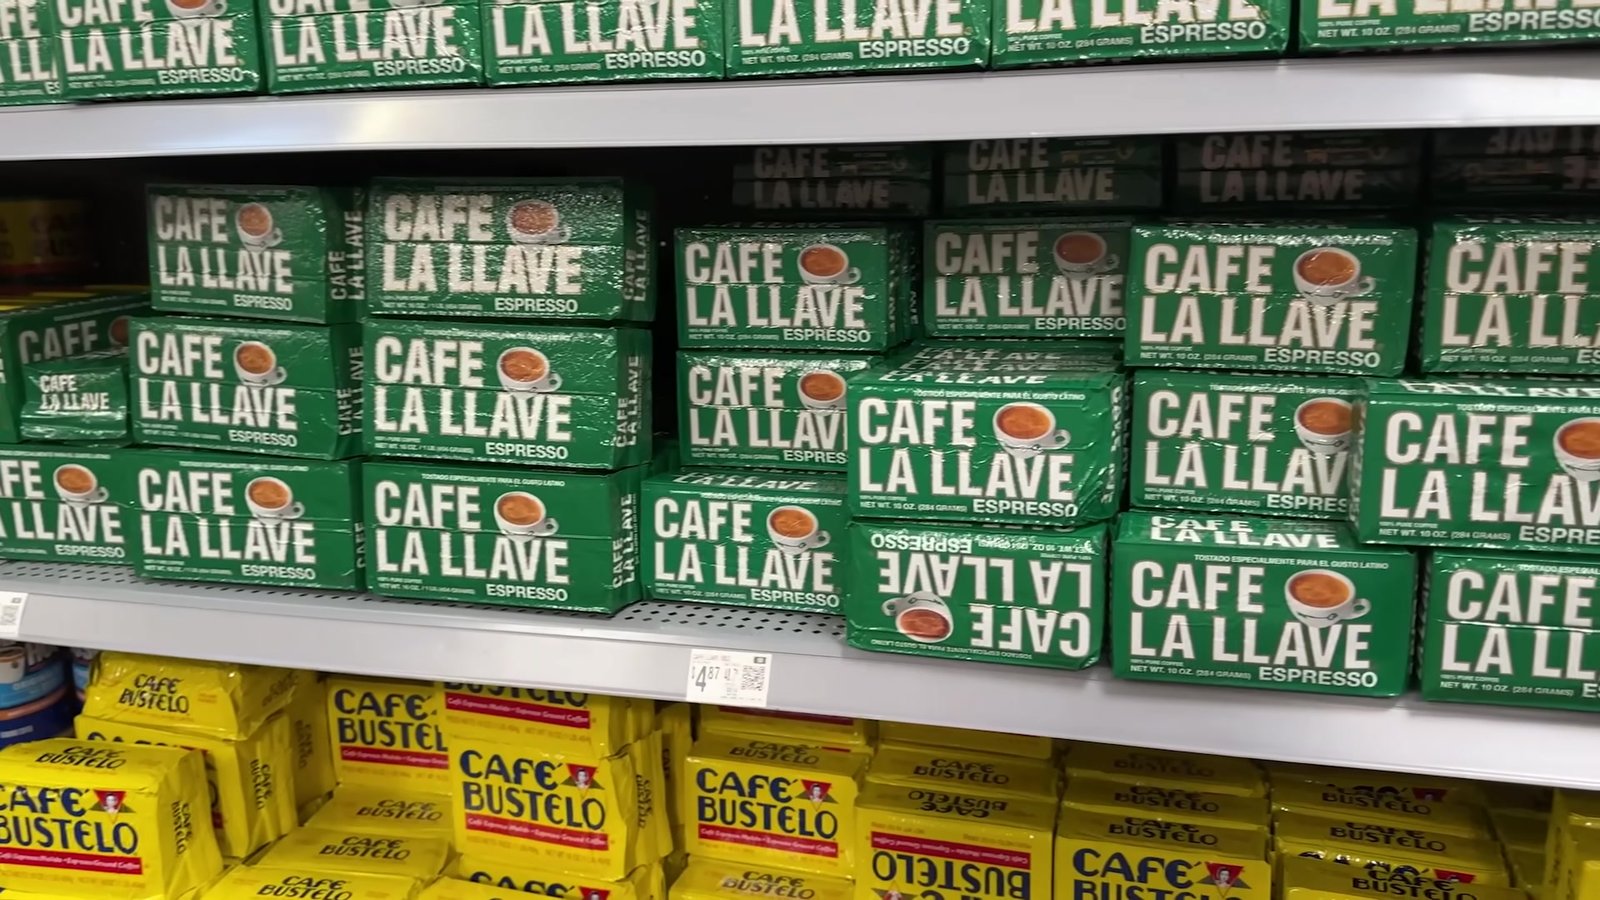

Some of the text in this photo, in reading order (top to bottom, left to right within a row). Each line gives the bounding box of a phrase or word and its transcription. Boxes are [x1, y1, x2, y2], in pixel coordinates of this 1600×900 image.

[272, 8, 458, 66] LA LLAVE
[495, 0, 699, 57] LA LLAVE
[740, 0, 802, 46] LA
[1141, 23, 1267, 44] ESPRESSO
[1318, 29, 1336, 38] NET
[1339, 29, 1358, 37] WT.
[1362, 27, 1372, 36] 10
[1375, 27, 1391, 36] OZ.
[1419, 24, 1460, 35] GRAMS)
[63, 20, 235, 73] LA LLAVE
[605, 51, 705, 70] ESPRESSO
[859, 38, 970, 59] ESPRESSO
[158, 67, 243, 85] ESPRESSO
[374, 59, 465, 76] ESPRESSO
[754, 148, 830, 179] CAFE
[968, 139, 1048, 171] CAFE
[1201, 136, 1293, 170] CAFE
[755, 180, 889, 209] LA LLAVE
[968, 170, 1114, 204] LA LLAVE
[1200, 170, 1366, 202] LA LLAVE
[154, 195, 228, 243] CAFE
[385, 195, 494, 241] CAFE
[157, 246, 293, 293] LA LLAVE
[383, 243, 584, 296] LA LLAVE
[686, 242, 784, 283] CAFE
[936, 232, 1039, 275] CAFE
[1145, 244, 1274, 294] CAFE
[1448, 241, 1590, 293] CAFE
[234, 295, 292, 311] ESPRESSO
[495, 298, 579, 313] ESPRESSO
[687, 287, 865, 329] LA LLAVE
[936, 276, 1125, 317] LA LLAVE
[784, 328, 871, 344] ESPRESSO
[1035, 317, 1126, 332] ESPRESSO
[1141, 297, 1378, 350] LA LLAVE
[1442, 297, 1511, 347] LA
[138, 331, 223, 378] CAFE
[376, 337, 483, 388] CAFE
[1265, 348, 1380, 368] ESPRESSO
[39, 375, 76, 392] CAFE
[64, 393, 109, 411] LLAVE
[690, 367, 785, 408] CAFE
[139, 379, 298, 430] LA LLAVE
[375, 387, 572, 440] LA LLAVE
[859, 398, 976, 446] CAFE
[1148, 391, 1275, 440] CAFE
[230, 430, 297, 447] ESPRESSO
[690, 408, 738, 446] LA
[1387, 412, 1534, 467] CAFE
[486, 442, 568, 459] ESPRESSO
[1145, 441, 1206, 488] LA
[139, 469, 234, 515] CAFE
[859, 449, 1074, 501] LA LLAVE
[1380, 468, 1451, 520] LA
[15, 502, 124, 544] LLAVE
[376, 481, 480, 529] CAFE
[655, 498, 754, 541] CAFE
[877, 502, 892, 510] WT.
[894, 502, 903, 510] 10
[973, 500, 1078, 518] ESPRESSO
[55, 545, 124, 558] ESPRESSO
[141, 516, 316, 563] LA LLAVE
[871, 534, 972, 553] ESPRESSO
[1151, 527, 1339, 548] LA LLAVE
[1379, 529, 1397, 537] NET
[1399, 530, 1415, 538] WT.
[1417, 530, 1427, 538] 10
[1429, 531, 1448, 539] OZ.
[242, 565, 316, 580] ESPRESSO
[376, 529, 569, 584] LA LLAVE
[656, 541, 835, 592] LA LLAVE
[1195, 554, 1230, 562] TOSTADO
[1232, 555, 1294, 565] ESPECIALMENTE
[1296, 559, 1318, 567] PARA
[1333, 560, 1358, 568] GUSTO
[1360, 561, 1388, 569] LATINO
[487, 584, 568, 602] ESPRESSO
[751, 589, 839, 609] ESPRESSO
[878, 552, 1092, 608] LA LLAVE
[1132, 560, 1263, 613] CAFE
[1448, 570, 1593, 627] CAFE
[971, 605, 1091, 657] CAFE
[1131, 613, 1371, 670] LA LLAVE
[1442, 624, 1513, 674] LA
[1180, 667, 1193, 675] OZ.
[1216, 670, 1251, 679] GRAMS)
[1259, 667, 1377, 688] ESPRESSO
[119, 689, 189, 713] BUSTELO
[36, 752, 127, 769] BUSTELO
[460, 750, 562, 790] CAFÉ
[913, 765, 1010, 786] BUSTELO
[697, 769, 798, 802] CAFÉ
[1114, 791, 1220, 813] BUSTELO
[357, 807, 442, 821] BUSTELO
[463, 783, 606, 830] BUSTELO
[698, 795, 838, 839] BUSTELO
[320, 845, 410, 861] BUSTELO
[1109, 824, 1218, 846] BUSTELO
[1330, 827, 1446, 853] BUSTELO
[1072, 848, 1202, 889] CAFÉ
[257, 885, 352, 900] BUSTELO
[723, 877, 815, 900] BUSTELO
